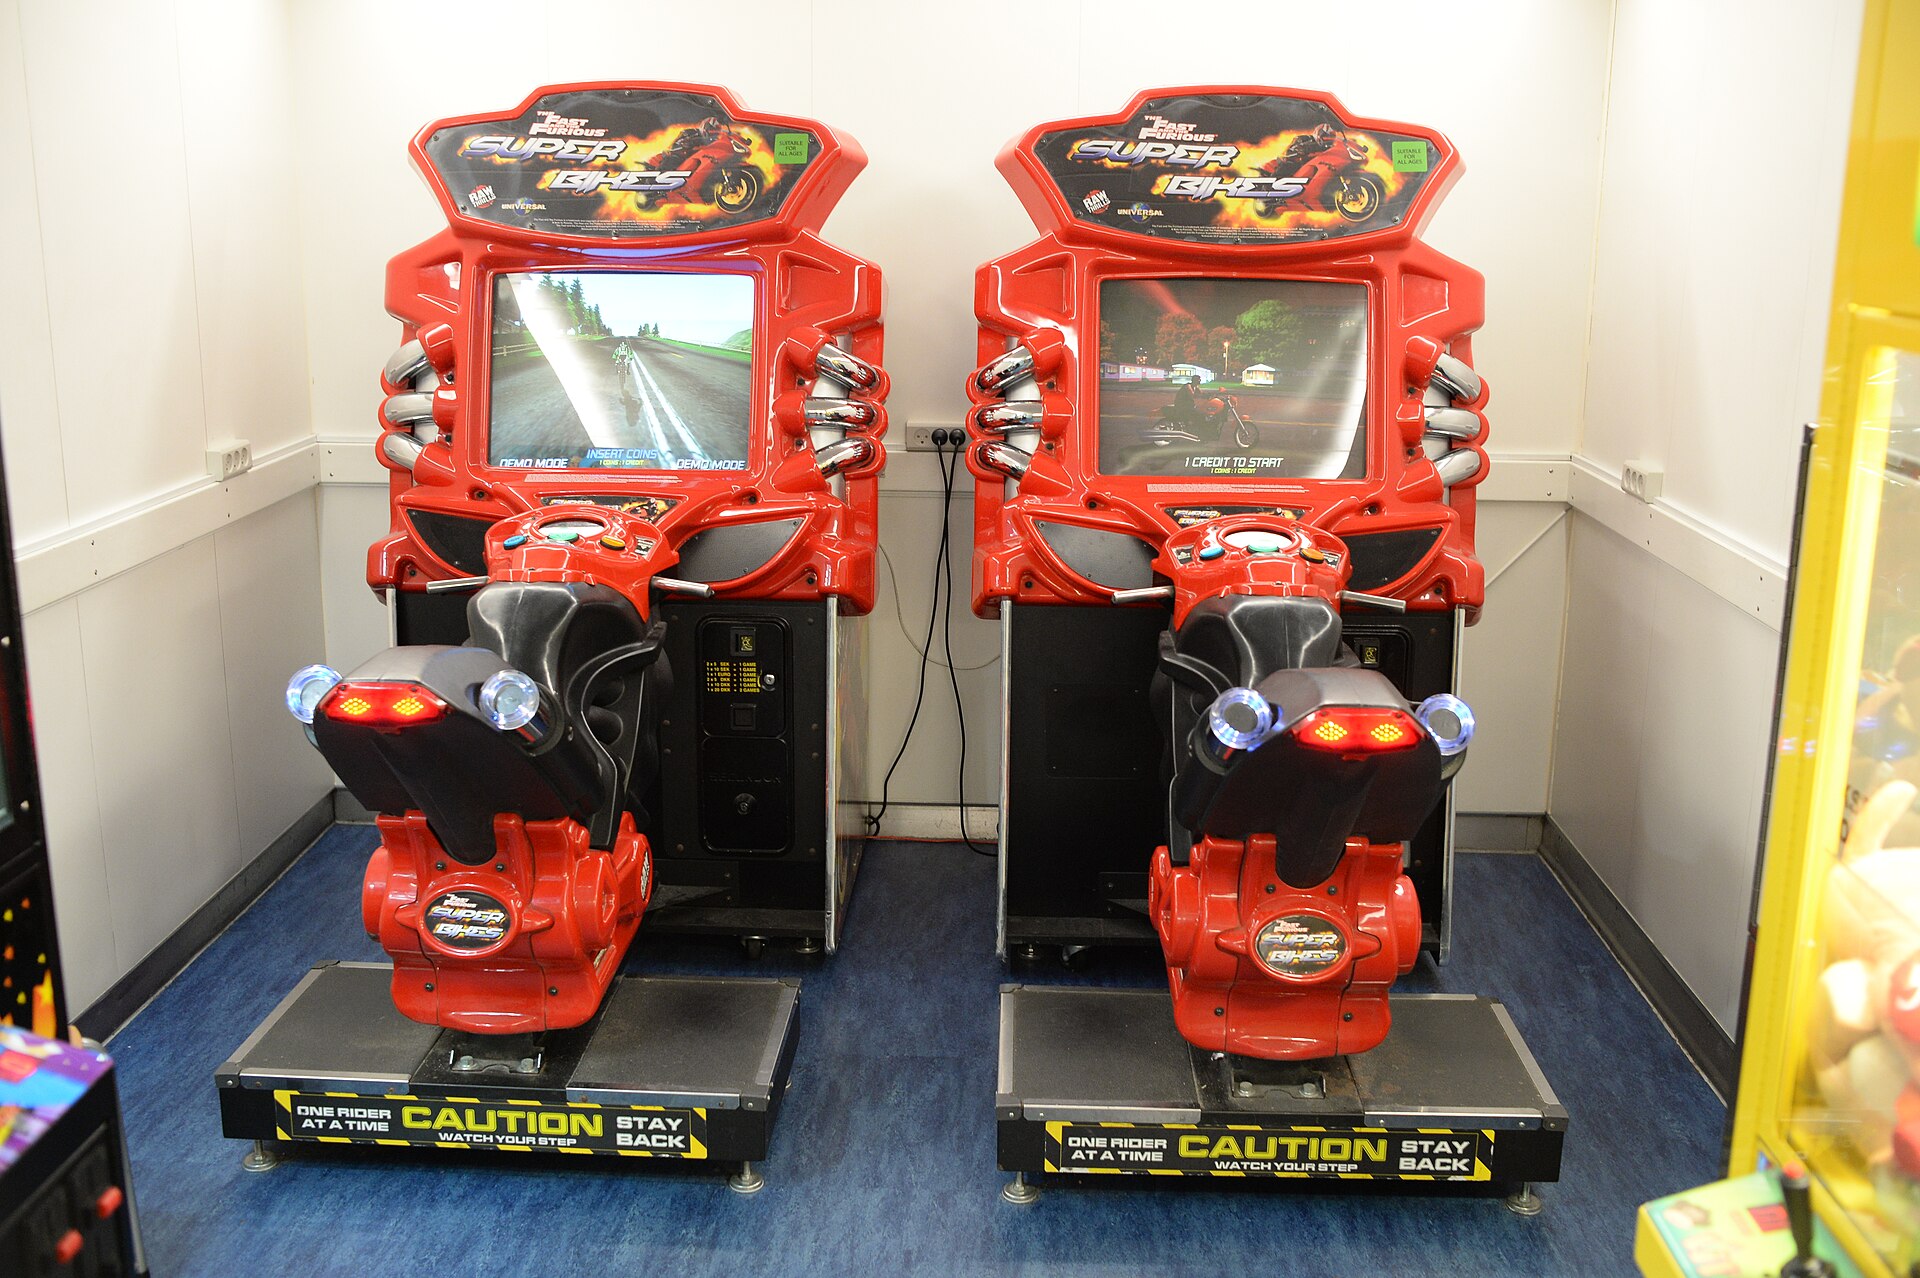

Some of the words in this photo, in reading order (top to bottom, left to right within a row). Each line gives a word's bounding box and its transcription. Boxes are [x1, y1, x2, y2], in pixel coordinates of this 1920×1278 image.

[544, 115, 589, 126] FAST
[1152, 119, 1197, 131] FAST
[529, 123, 606, 137] FURIOUS
[1138, 127, 1216, 142] FURIOUS
[463, 135, 628, 164] SUPER
[1073, 140, 1240, 169] SUPER
[548, 169, 692, 194] BIKES
[1164, 176, 1309, 200] BIKES
[468, 185, 494, 200] RAW
[1083, 190, 1109, 207] RAW
[1117, 208, 1164, 216] UNIVERSAL
[586, 448, 625, 459] INSERT
[626, 449, 658, 459] COINS
[500, 458, 533, 468] DEMO
[534, 458, 569, 468] MODE
[676, 459, 711, 470] DEMO
[711, 460, 746, 470] MODE
[1185, 457, 1190, 467] 1
[1192, 457, 1230, 468] CREDIT
[1233, 457, 1247, 468] TO
[1248, 458, 1284, 468] START
[432, 907, 505, 924] SUPER
[436, 923, 504, 938] BIKES
[1262, 934, 1338, 947] SUPER
[1269, 950, 1338, 964] BIKES
[297, 1106, 335, 1117] ONE
[337, 1107, 391, 1119] RIDER
[302, 1119, 327, 1129] AT
[328, 1121, 346, 1130] A
[347, 1121, 389, 1132] TIME
[401, 1105, 604, 1137] CAUTION
[616, 1116, 683, 1131] STAY
[438, 1132, 494, 1143] WATCH
[495, 1135, 536, 1145] YOUR
[538, 1137, 577, 1146] STEP
[616, 1133, 685, 1148] BACK
[1068, 1136, 1107, 1148] ONE
[1110, 1138, 1167, 1149] RIDER
[1178, 1135, 1388, 1162] CAUTION
[1401, 1140, 1470, 1154] STAY
[1071, 1150, 1098, 1160] AT
[1099, 1151, 1117, 1161] A
[1118, 1151, 1163, 1162] TIME
[1214, 1161, 1272, 1170] WATCH
[1273, 1162, 1316, 1171] YOUR
[1318, 1163, 1358, 1172] STEP
[1399, 1157, 1470, 1171] BACK
